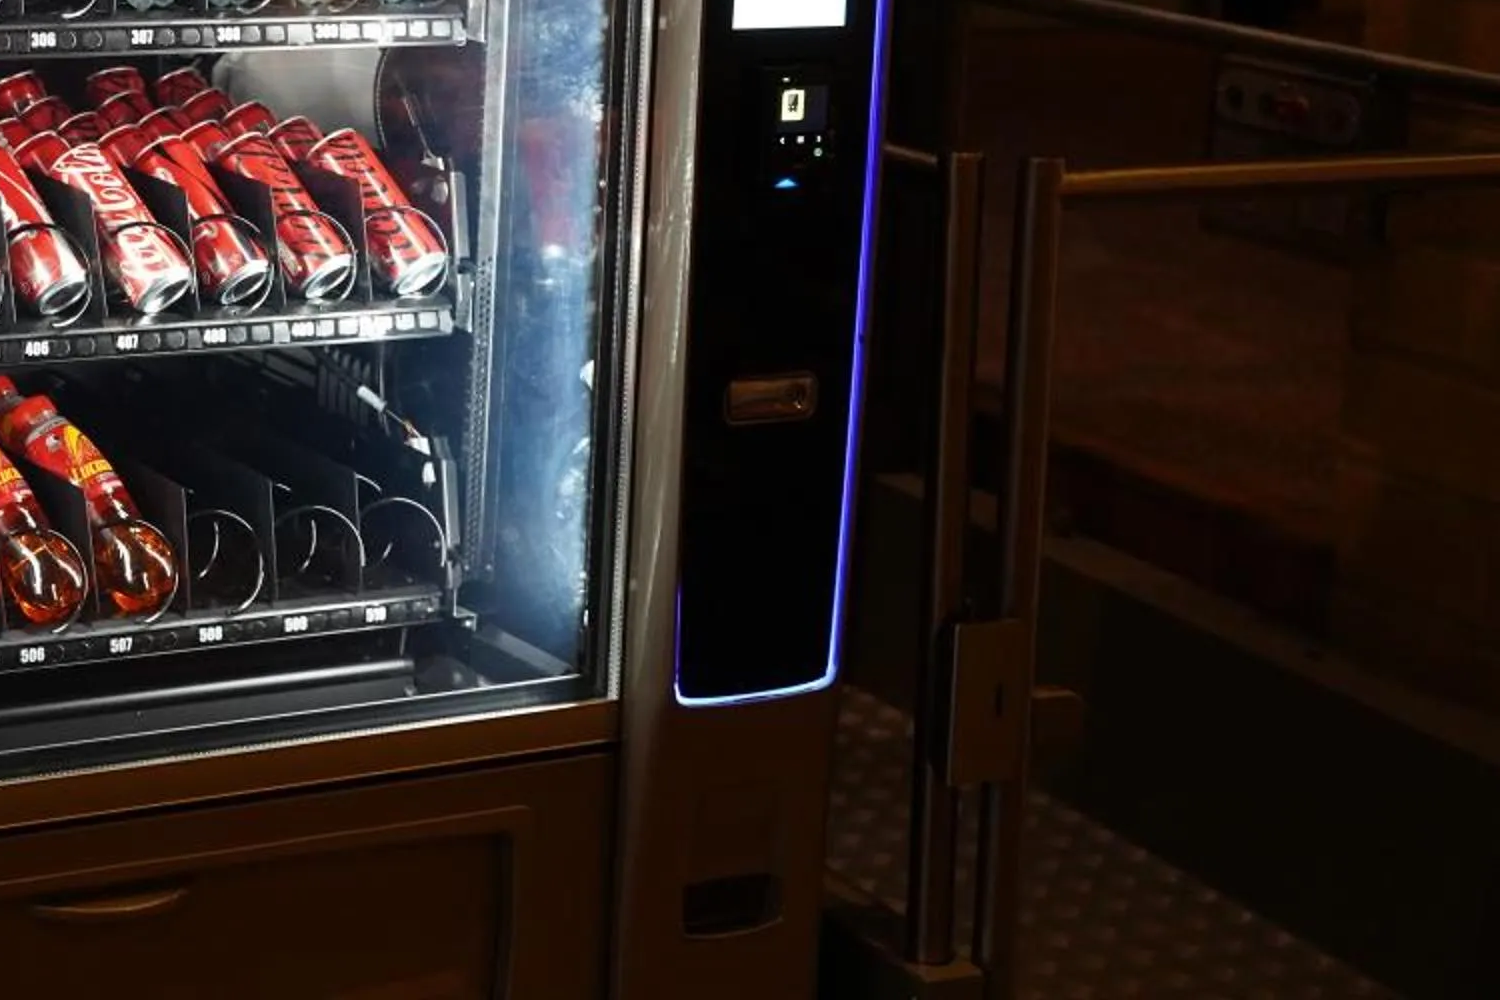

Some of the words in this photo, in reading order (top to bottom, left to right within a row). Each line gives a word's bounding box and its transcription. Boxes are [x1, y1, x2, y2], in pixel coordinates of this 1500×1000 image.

[31, 31, 57, 48] 306
[131, 29, 154, 45] 307
[25, 340, 50, 357] 406
[116, 333, 139, 350] 407
[110, 637, 133, 653] 507
[20, 647, 45, 663] 506
